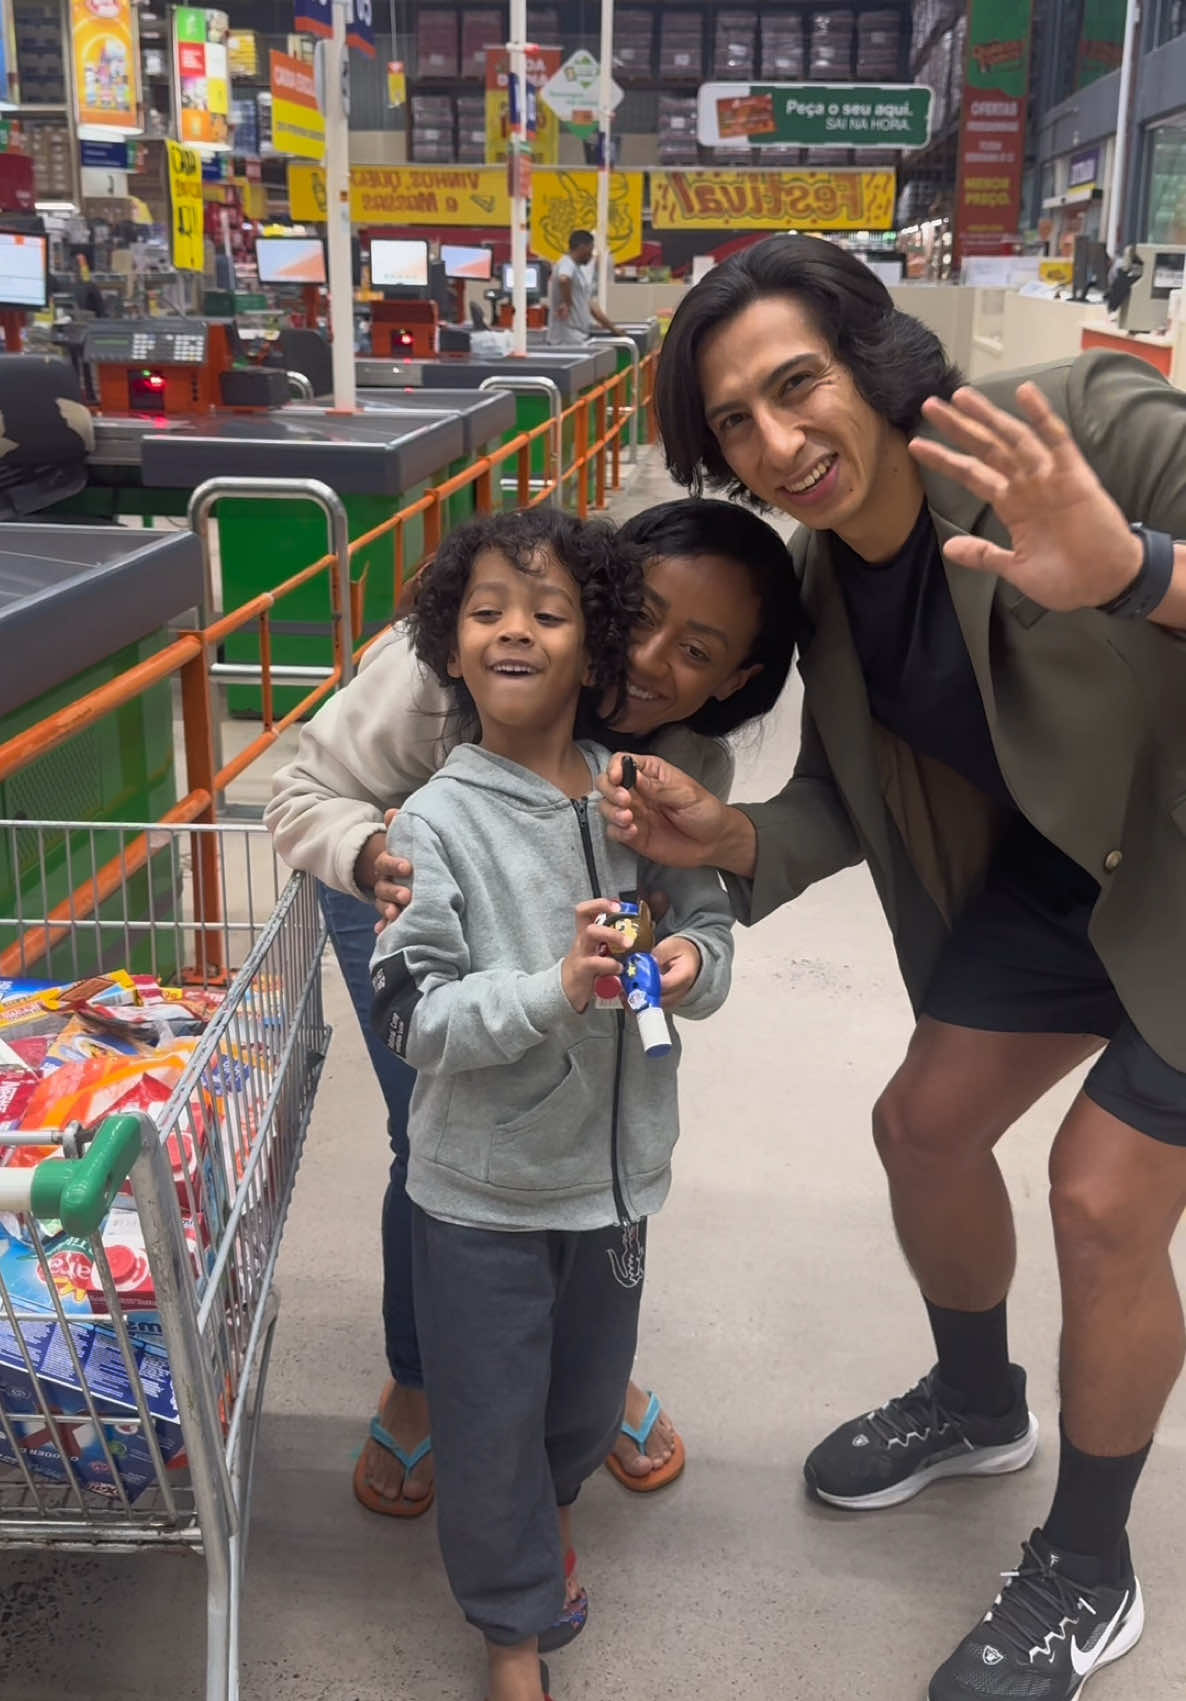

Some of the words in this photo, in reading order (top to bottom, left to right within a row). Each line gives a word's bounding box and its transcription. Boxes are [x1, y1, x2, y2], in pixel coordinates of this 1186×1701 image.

[786, 99, 825, 118] Peça
[827, 103, 839, 116] o
[842, 103, 871, 116] seu
[874, 101, 914, 118] aqui.
[825, 117, 847, 130] SAI
[848, 117, 868, 131] NA
